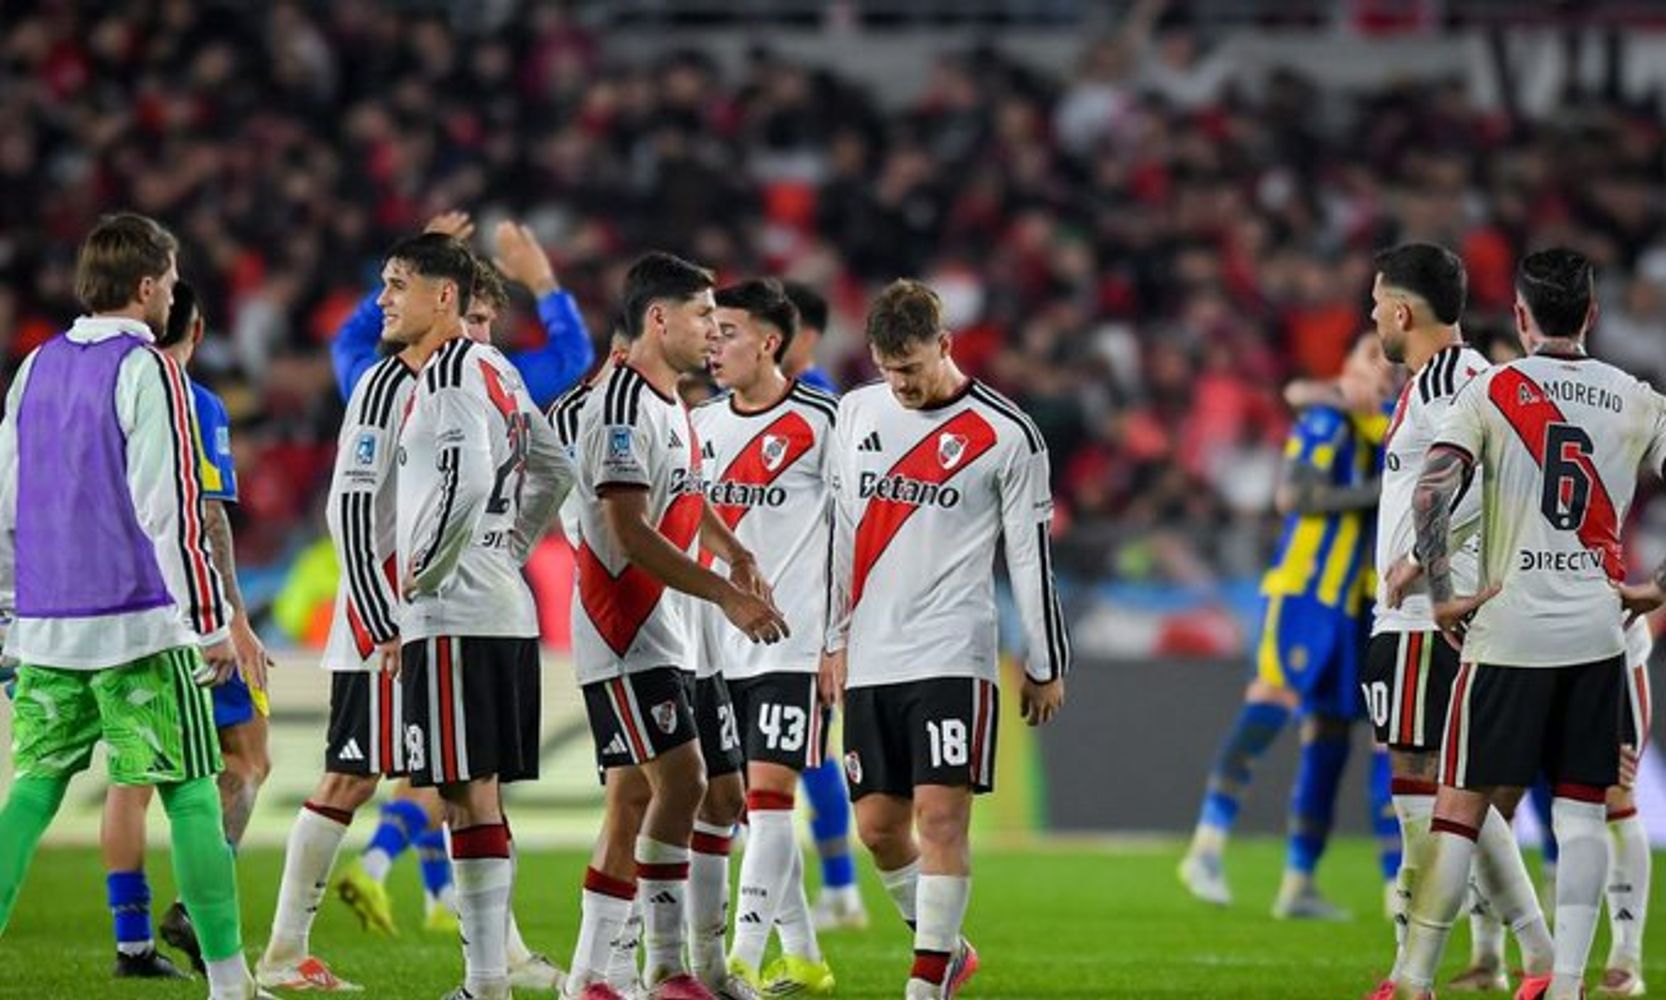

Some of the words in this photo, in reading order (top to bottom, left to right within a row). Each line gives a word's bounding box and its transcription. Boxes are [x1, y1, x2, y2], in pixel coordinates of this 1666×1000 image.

[1543, 379, 1623, 413] MORENO
[701, 478, 787, 507] etano
[859, 472, 959, 508] Betano
[1541, 423, 1594, 531] 6
[1520, 550, 1603, 571] DIRECTV
[758, 703, 806, 751] 43
[927, 719, 968, 768] 18
